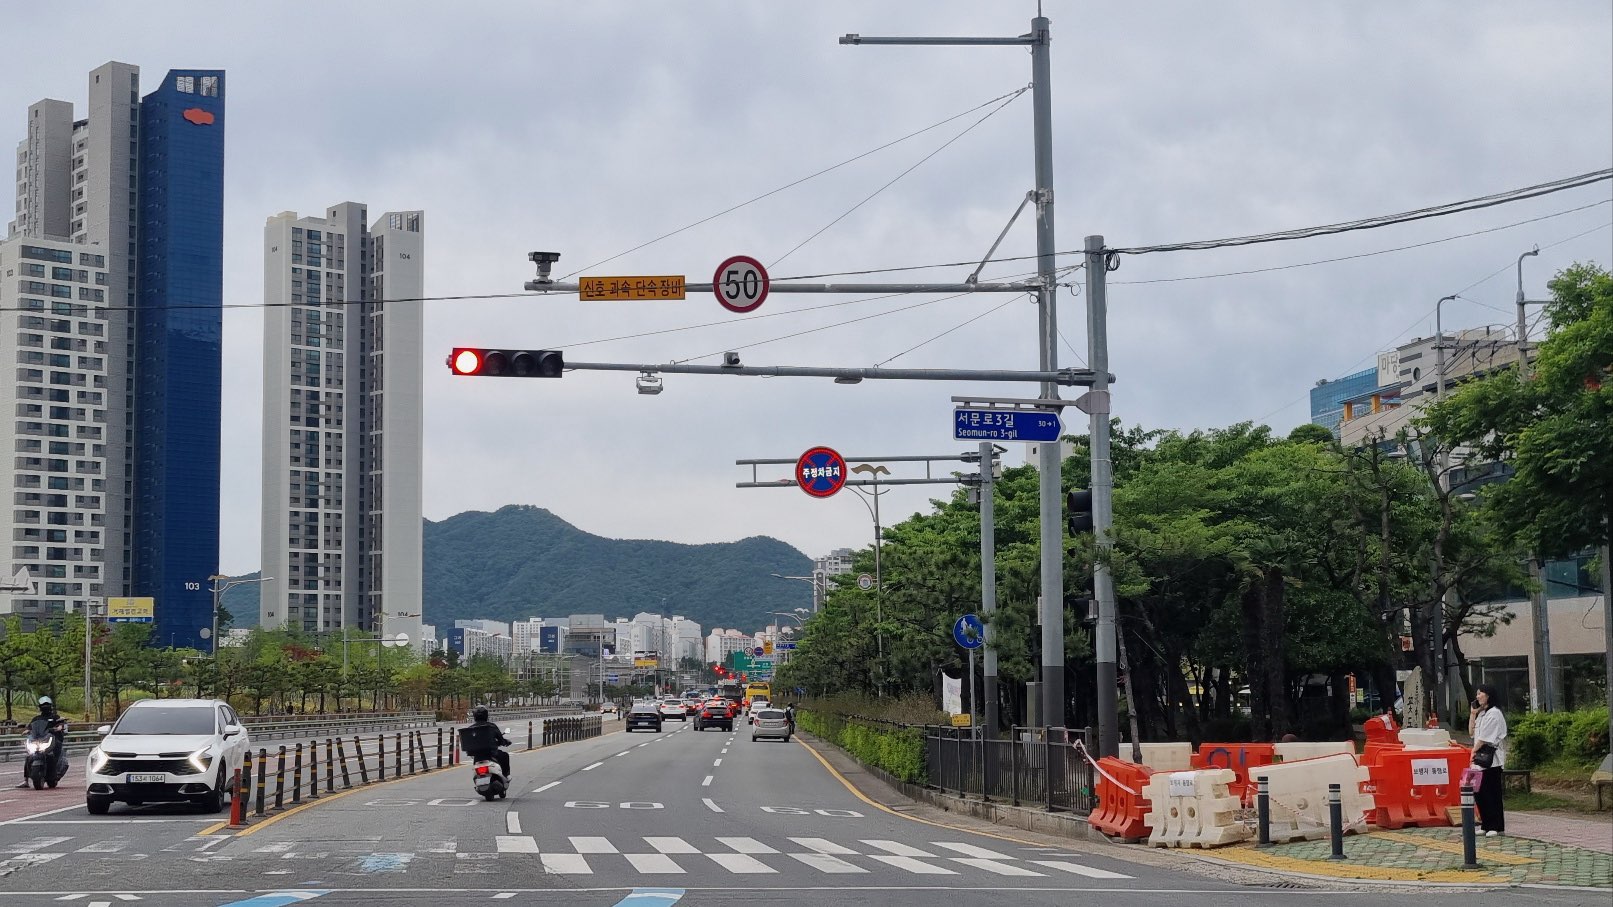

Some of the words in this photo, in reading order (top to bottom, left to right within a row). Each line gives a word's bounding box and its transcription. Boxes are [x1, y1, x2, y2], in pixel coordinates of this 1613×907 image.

[584, 280, 606, 298] 신호
[609, 280, 631, 298] 과속
[636, 279, 657, 297] 단속
[660, 279, 681, 297] 장비
[725, 269, 758, 300] 50
[958, 412, 1014, 428] 서문로3길
[958, 428, 998, 437] Seomun-ro
[1000, 429, 1018, 439] 3-gil
[802, 466, 840, 478] 주정차금지
[184, 582, 200, 590] 103
